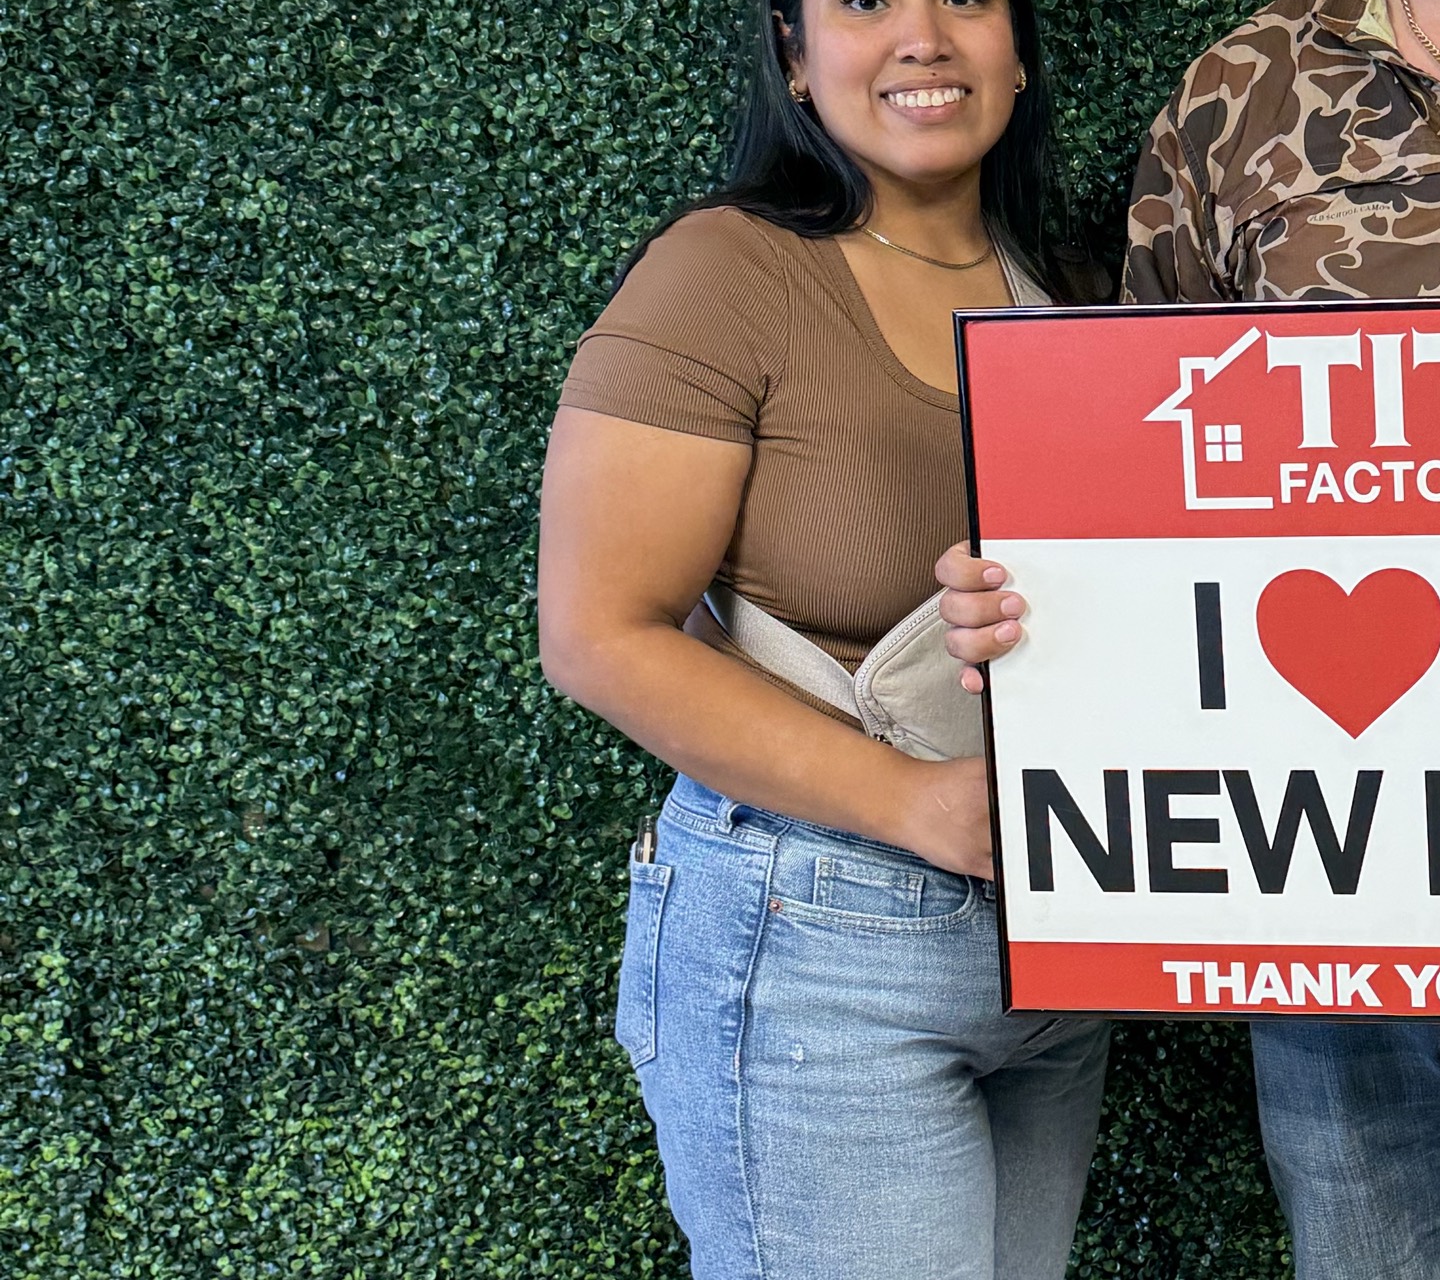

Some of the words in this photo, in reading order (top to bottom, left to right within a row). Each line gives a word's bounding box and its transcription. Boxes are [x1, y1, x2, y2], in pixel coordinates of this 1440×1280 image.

[1194, 582, 1227, 710] I
[1021, 768, 1384, 895] NEW
[1162, 960, 1383, 1007] THANK
